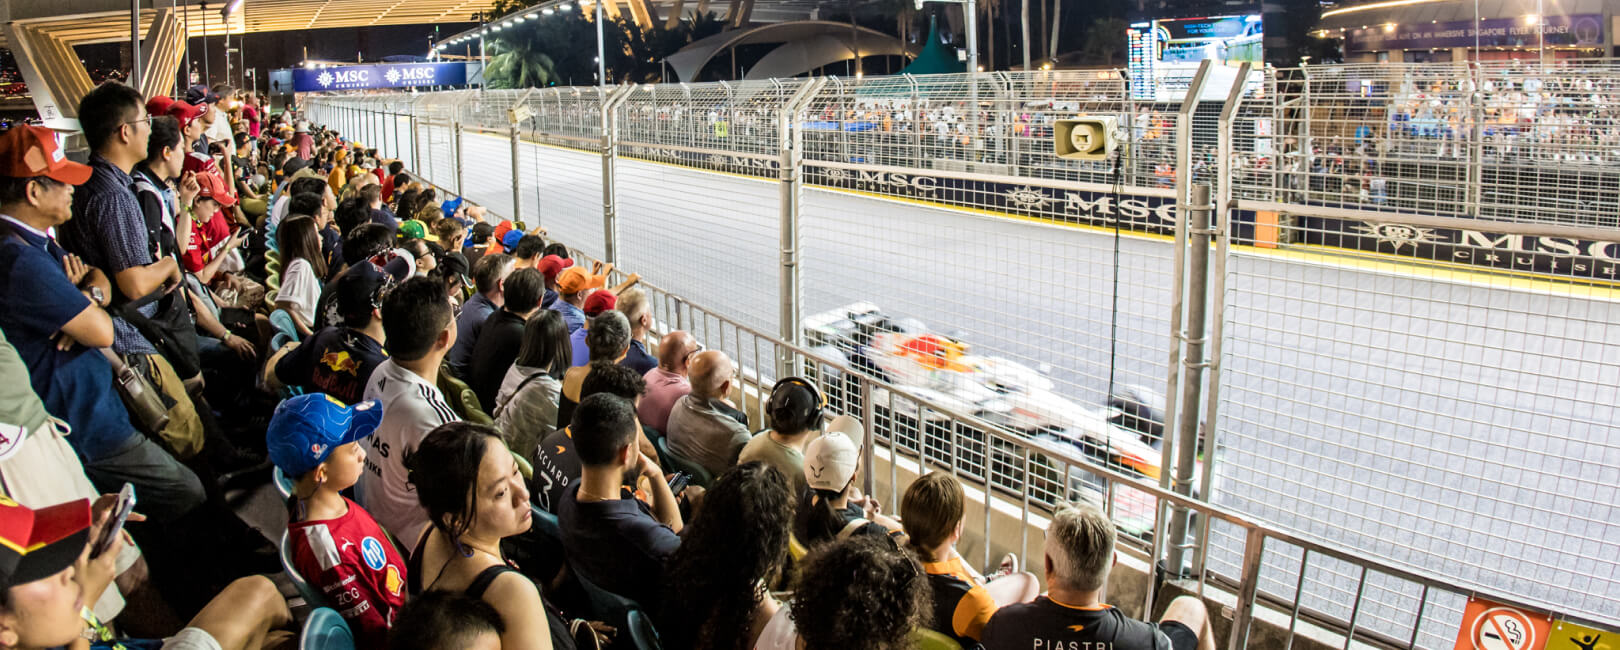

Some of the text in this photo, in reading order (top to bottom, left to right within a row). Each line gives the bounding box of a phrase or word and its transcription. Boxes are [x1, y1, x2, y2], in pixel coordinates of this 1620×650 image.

[1467, 27, 1506, 37] SIGAPORE
[335, 70, 369, 83] MSC
[402, 67, 435, 80] MSC
[649, 148, 682, 159] MSC
[732, 156, 779, 169] MSC
[859, 169, 938, 191] MSC
[1064, 192, 1177, 222] MSC
[1462, 229, 1620, 264] MSC
[538, 470, 553, 512] 3
[362, 540, 384, 568] hp
[1033, 638, 1114, 650] PIASTRI
